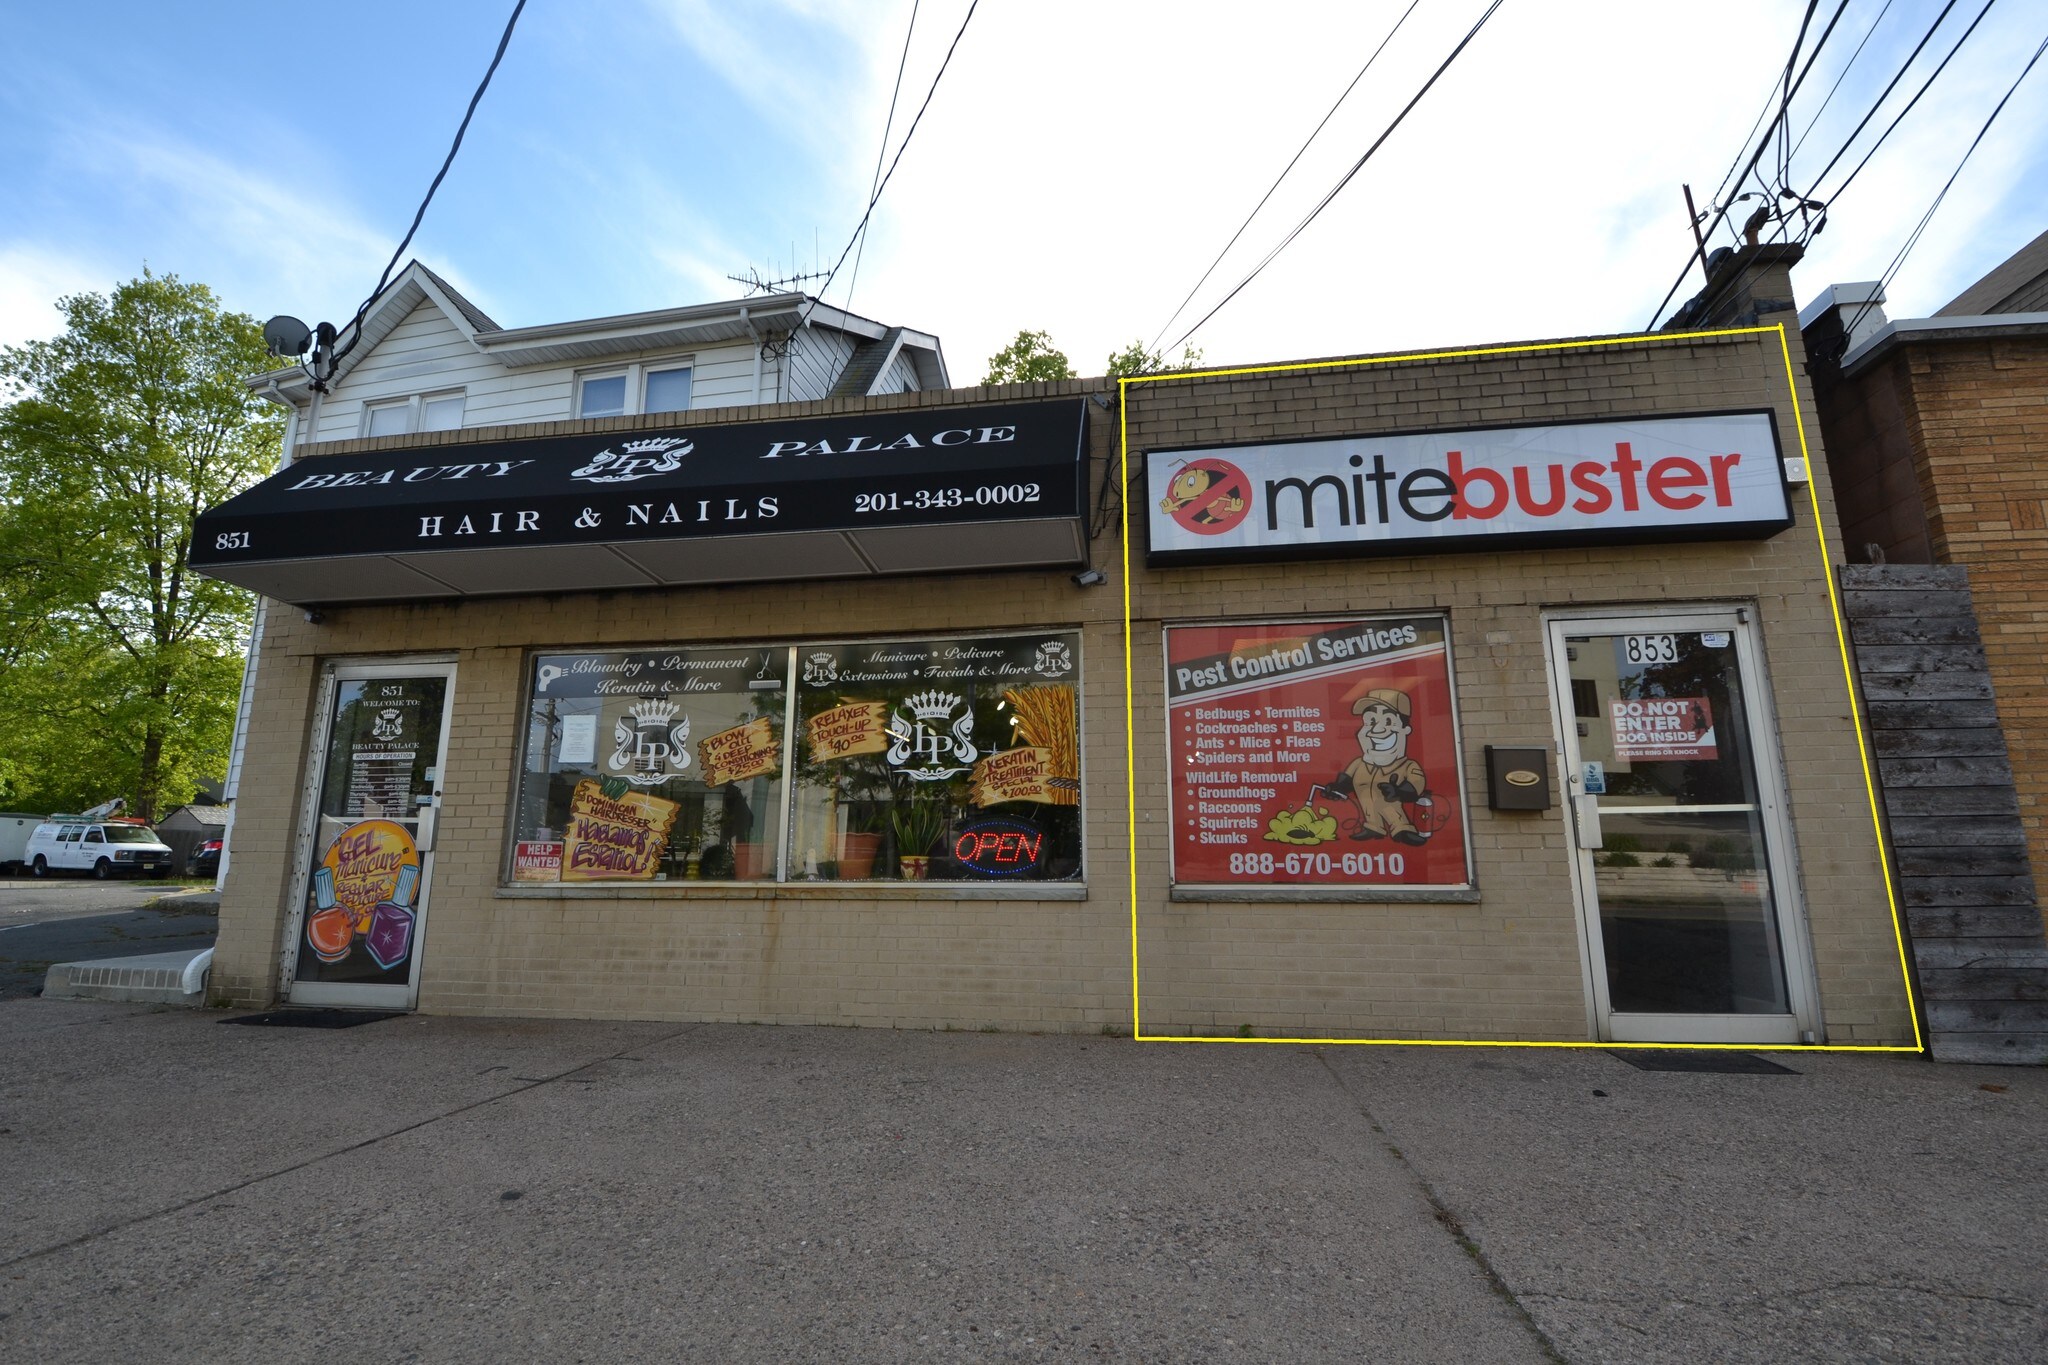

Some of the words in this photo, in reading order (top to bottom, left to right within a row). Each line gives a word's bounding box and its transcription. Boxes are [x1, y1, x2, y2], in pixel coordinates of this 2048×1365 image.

[284, 459, 536, 491] BEAUTY
[759, 426, 1016, 458] PALACE
[1265, 442, 1741, 530] mitebuster
[854, 484, 1040, 513] 201-343-0002
[418, 510, 540, 537] HAIR
[574, 507, 601, 528] &
[626, 497, 779, 525] NAILS
[215, 531, 251, 550] 851
[863, 650, 928, 663] Manicure
[943, 646, 1004, 660] Pedicure
[1176, 661, 1227, 690] Pest
[1231, 643, 1313, 678] Control
[1317, 624, 1417, 661] Services
[1627, 636, 1675, 662] 853
[571, 657, 643, 677] Blowdry
[660, 655, 750, 671] Permanent
[839, 670, 909, 682] Extensions
[923, 665, 975, 678] Facials
[978, 665, 992, 676] &
[992, 662, 1031, 676] More
[381, 686, 403, 696] 851
[594, 678, 656, 694] Keratin
[660, 680, 674, 692] &
[675, 676, 721, 692] More
[813, 705, 870, 729] RELAXER
[1195, 708, 1250, 721] Bedbugs
[1264, 706, 1320, 718] Termites
[1613, 703, 1643, 716] DO
[1647, 701, 1689, 715] NOT
[814, 719, 872, 741] TOUCH-UP
[1195, 722, 1278, 734] Cockroaches
[1293, 721, 1325, 732] Bees
[1614, 716, 1681, 731] ENTER
[710, 728, 746, 751] BLOW
[1196, 737, 1225, 749] Ants
[1239, 736, 1270, 748] Mice
[1286, 735, 1321, 747] Fleas
[1616, 732, 1648, 743] DOG
[1650, 731, 1696, 742] INSIDE
[714, 746, 772, 770] CONDITIONING
[723, 744, 752, 759] DEEP
[1197, 751, 1246, 765] Spiders
[1249, 750, 1273, 762] and
[1277, 750, 1311, 762] More
[986, 749, 1037, 773] KERATIN
[983, 761, 1046, 783] TREATMENT
[1186, 771, 1238, 784] WildLife
[1241, 770, 1298, 783] Removal
[992, 776, 1039, 791] SPECIAL
[1198, 786, 1276, 800] Groundhogs
[586, 794, 637, 816] DOMINICAN
[1199, 802, 1262, 813] Raccoons
[1199, 817, 1258, 830] Squirrels
[1200, 832, 1248, 844] Skunks
[527, 844, 553, 855] HELP
[955, 832, 1042, 863] OPEN
[518, 856, 560, 868] WANTED
[1229, 853, 1405, 875] 888-670-6010
